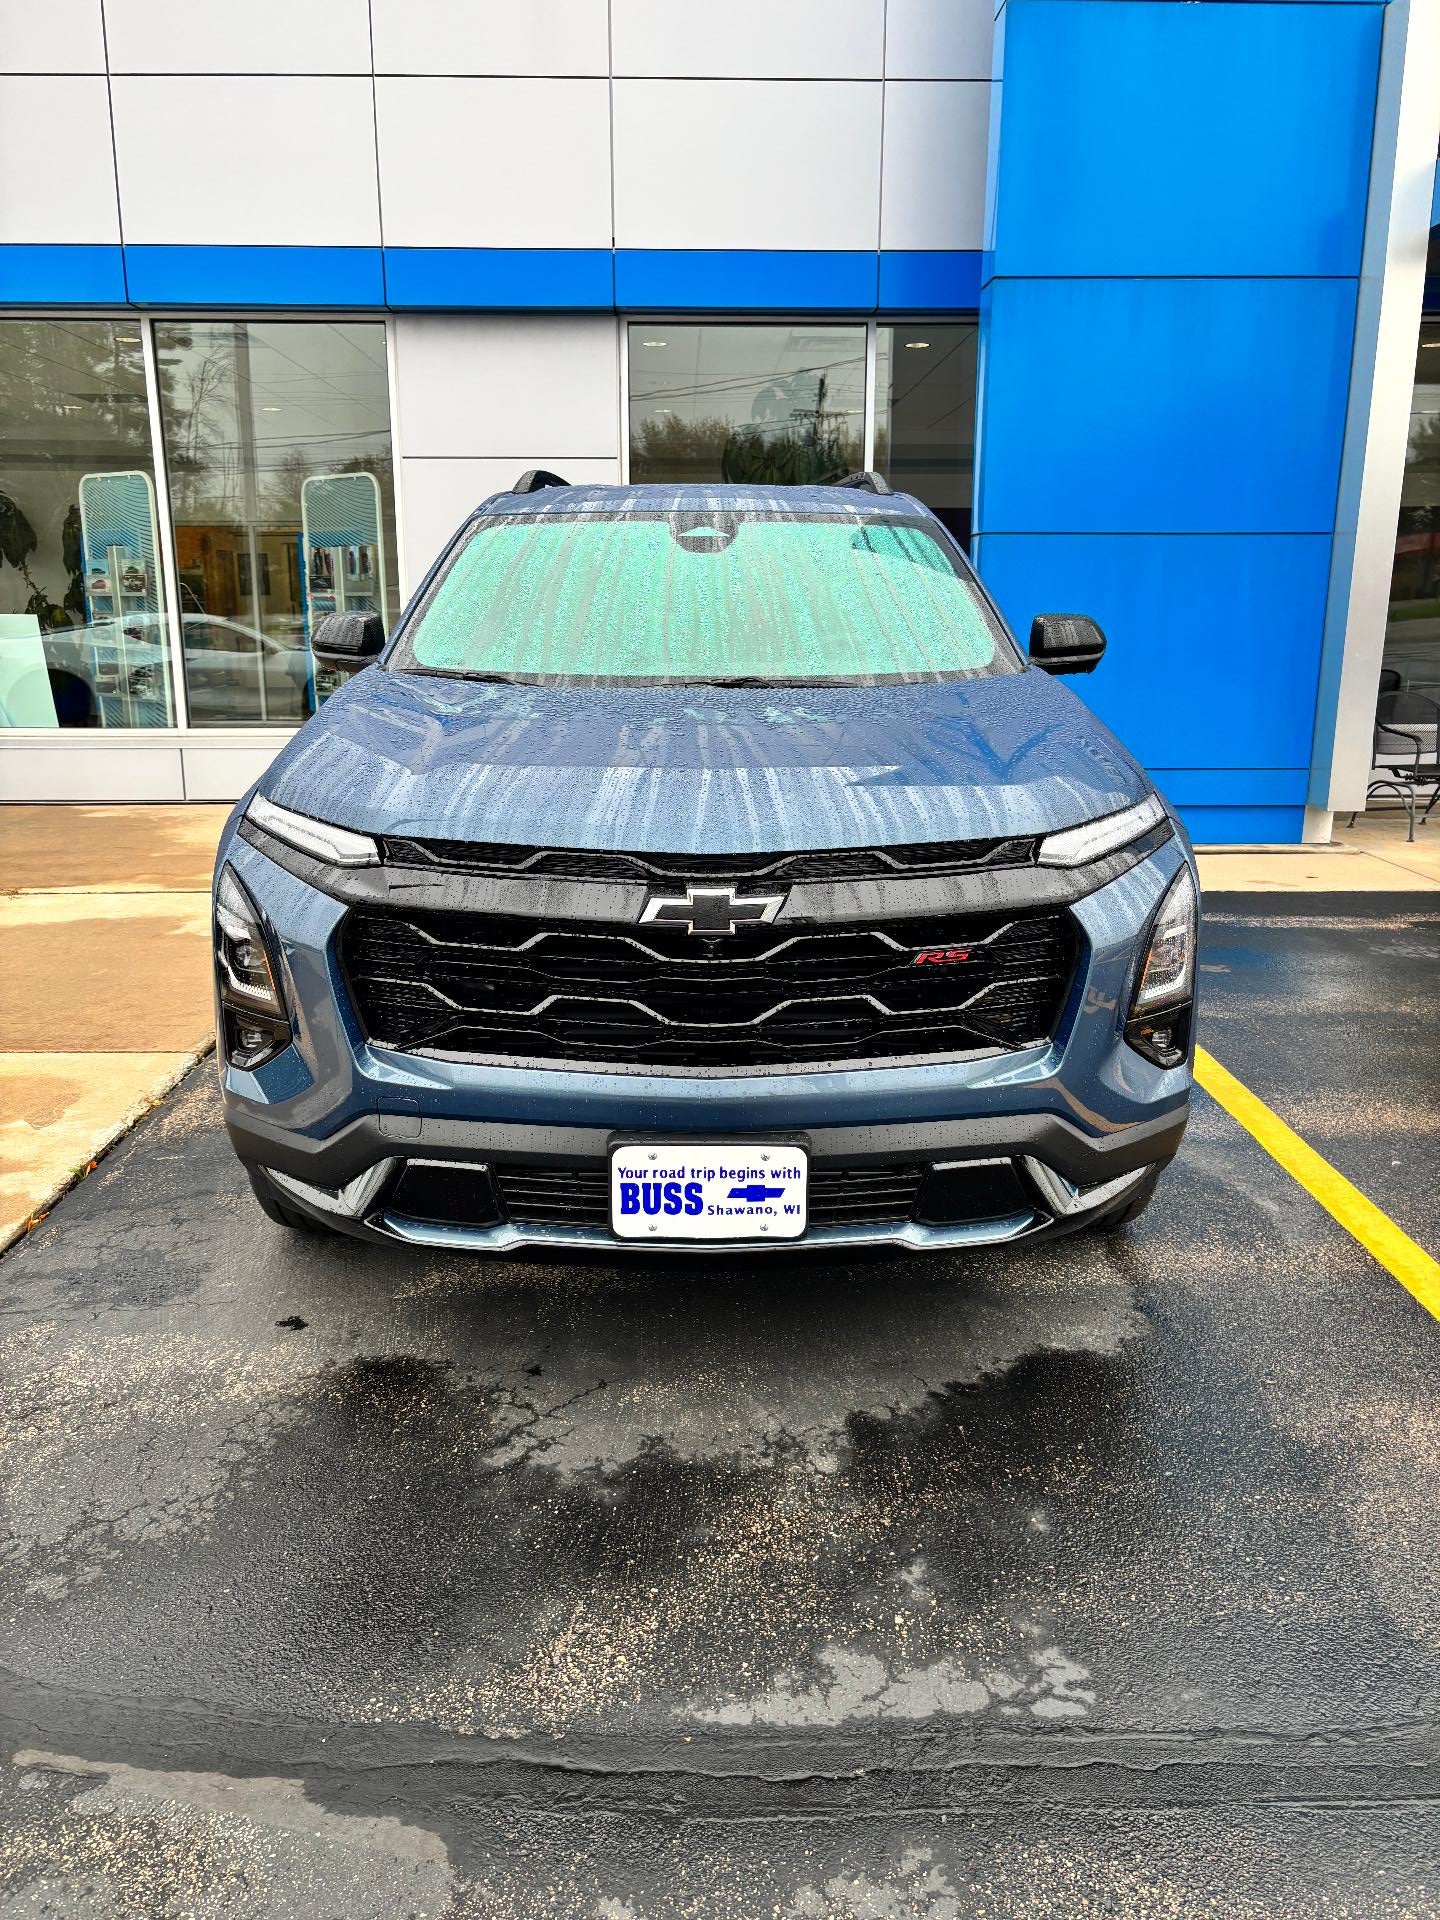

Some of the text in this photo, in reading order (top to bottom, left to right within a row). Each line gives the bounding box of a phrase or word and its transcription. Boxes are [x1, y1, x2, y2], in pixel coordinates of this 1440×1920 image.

[914, 949, 972, 965] RS
[618, 1166, 800, 1182] Your road trip begins with
[620, 1182, 703, 1215] BUSS
[708, 1205, 800, 1216] Shawano, WI
